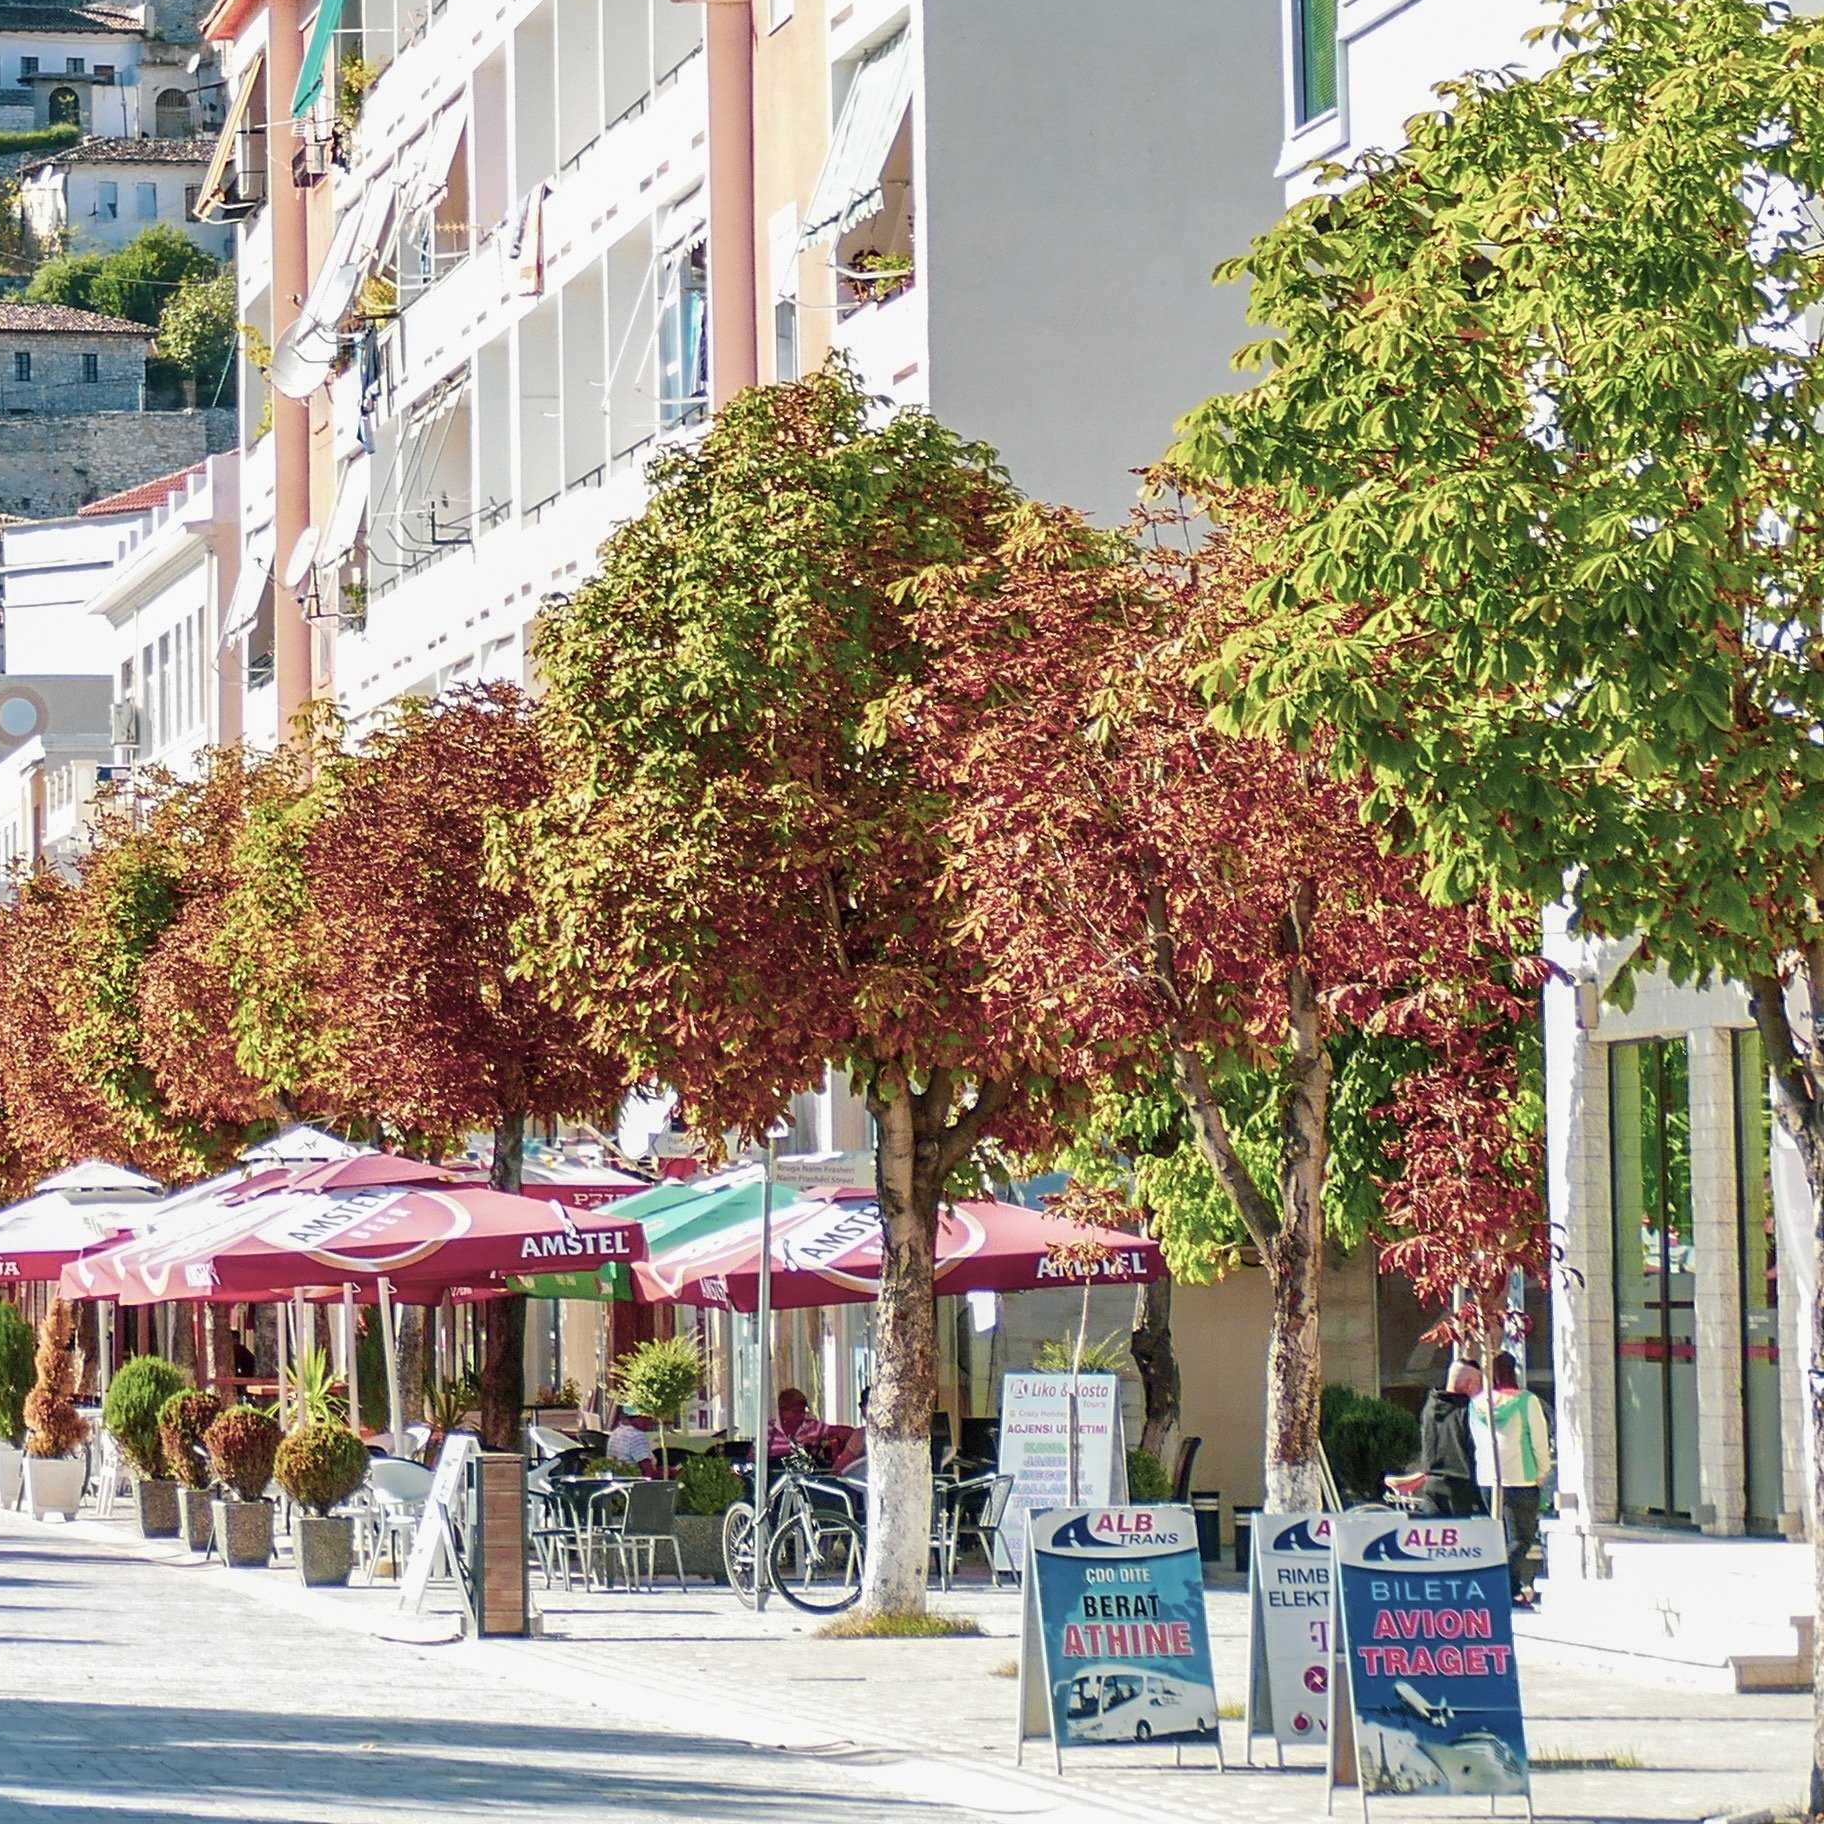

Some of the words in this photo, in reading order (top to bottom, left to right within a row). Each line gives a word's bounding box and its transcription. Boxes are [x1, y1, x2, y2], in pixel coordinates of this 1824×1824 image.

[521, 1232, 630, 1259] AMSTEL
[1007, 1423, 1053, 1434] AGJENSI
[1056, 1424, 1108, 1434] UDETIMI
[1095, 1513, 1153, 1533] ALB
[1120, 1533, 1179, 1545] TRANS
[1405, 1529, 1458, 1546] ALB
[1427, 1547, 1482, 1558] TRANS
[1120, 1568, 1152, 1583] DITE
[1277, 1568, 1329, 1585] RIMB
[1269, 1591, 1329, 1607] ELEKT
[1371, 1580, 1486, 1602] BILETA
[1083, 1594, 1160, 1619] BERAT
[1373, 1608, 1492, 1639] AVION
[1063, 1621, 1194, 1658] ATHINE
[1358, 1644, 1512, 1677] TRAGET
